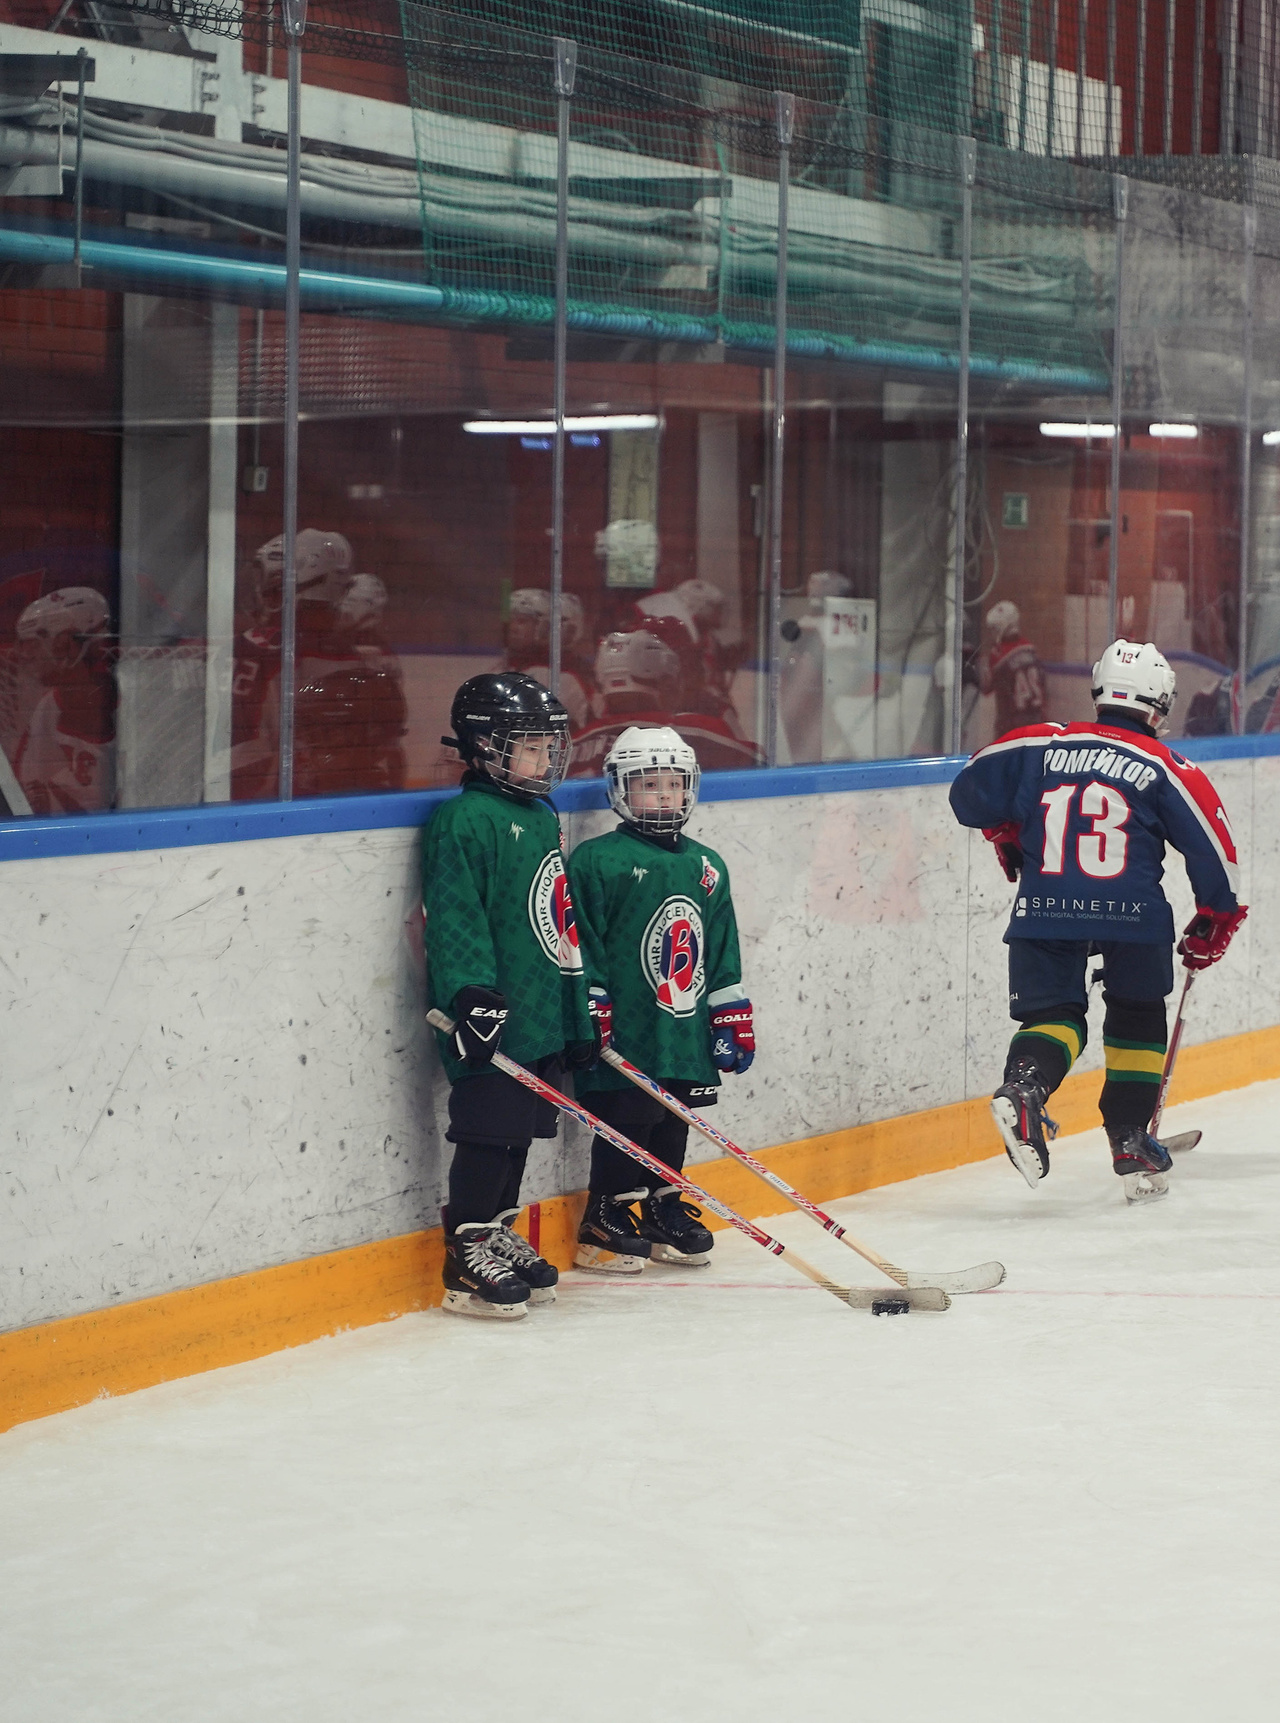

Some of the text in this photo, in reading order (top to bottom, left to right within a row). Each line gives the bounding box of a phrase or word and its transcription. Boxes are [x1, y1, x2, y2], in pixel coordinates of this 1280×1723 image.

[1121, 652, 1134, 664] 13
[1043, 747, 1158, 791] РОМЕЙКОВ
[1040, 780, 1132, 880] 13
[539, 906, 559, 949] VIKHR
[1050, 911, 1075, 919] DIGITAL
[1105, 914, 1141, 922] SOLUTIONS
